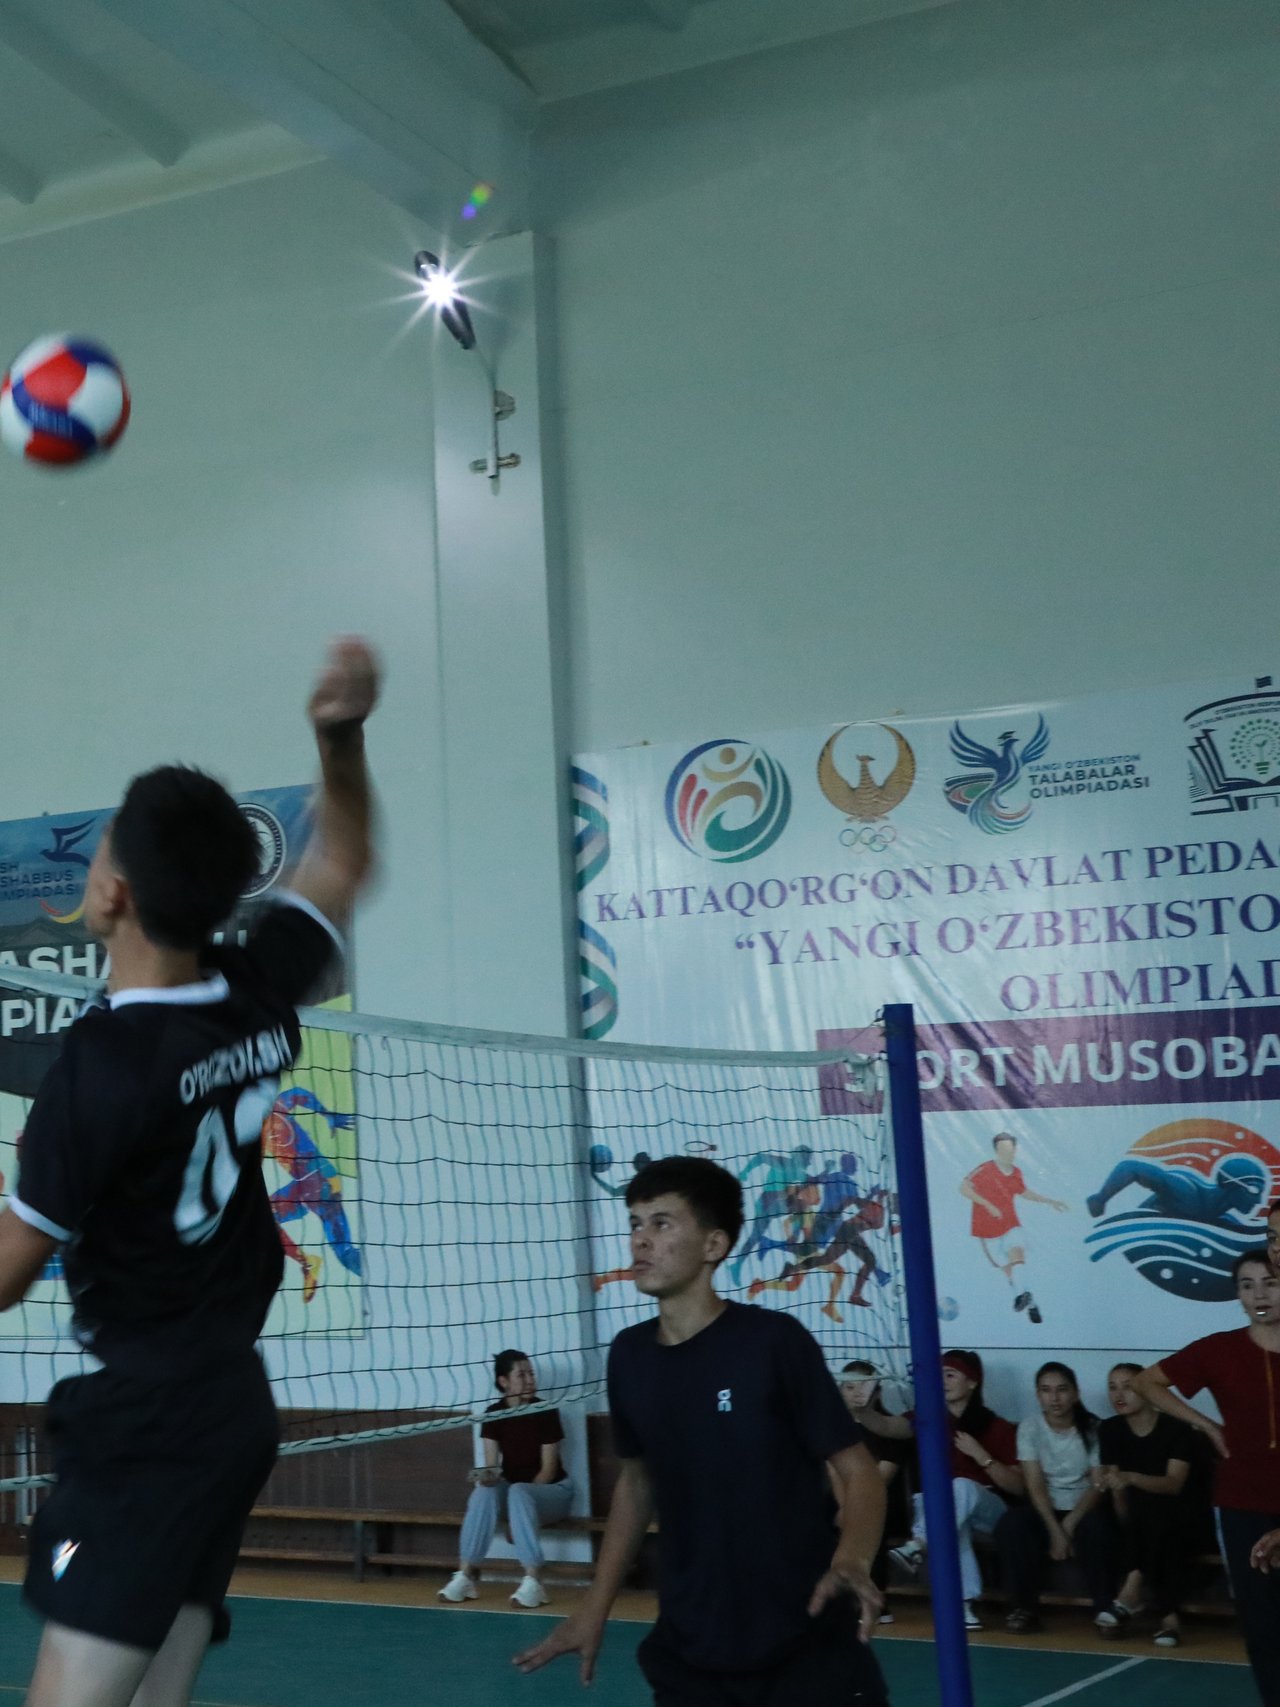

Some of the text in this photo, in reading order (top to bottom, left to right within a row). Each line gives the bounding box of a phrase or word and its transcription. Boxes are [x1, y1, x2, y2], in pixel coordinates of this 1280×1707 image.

[1028, 764, 1135, 786] TALABALAR
[1030, 776, 1151, 799] OLIMPIADASI
[946, 848, 1132, 895] DAVLAT
[1143, 837, 1280, 880] PEDA
